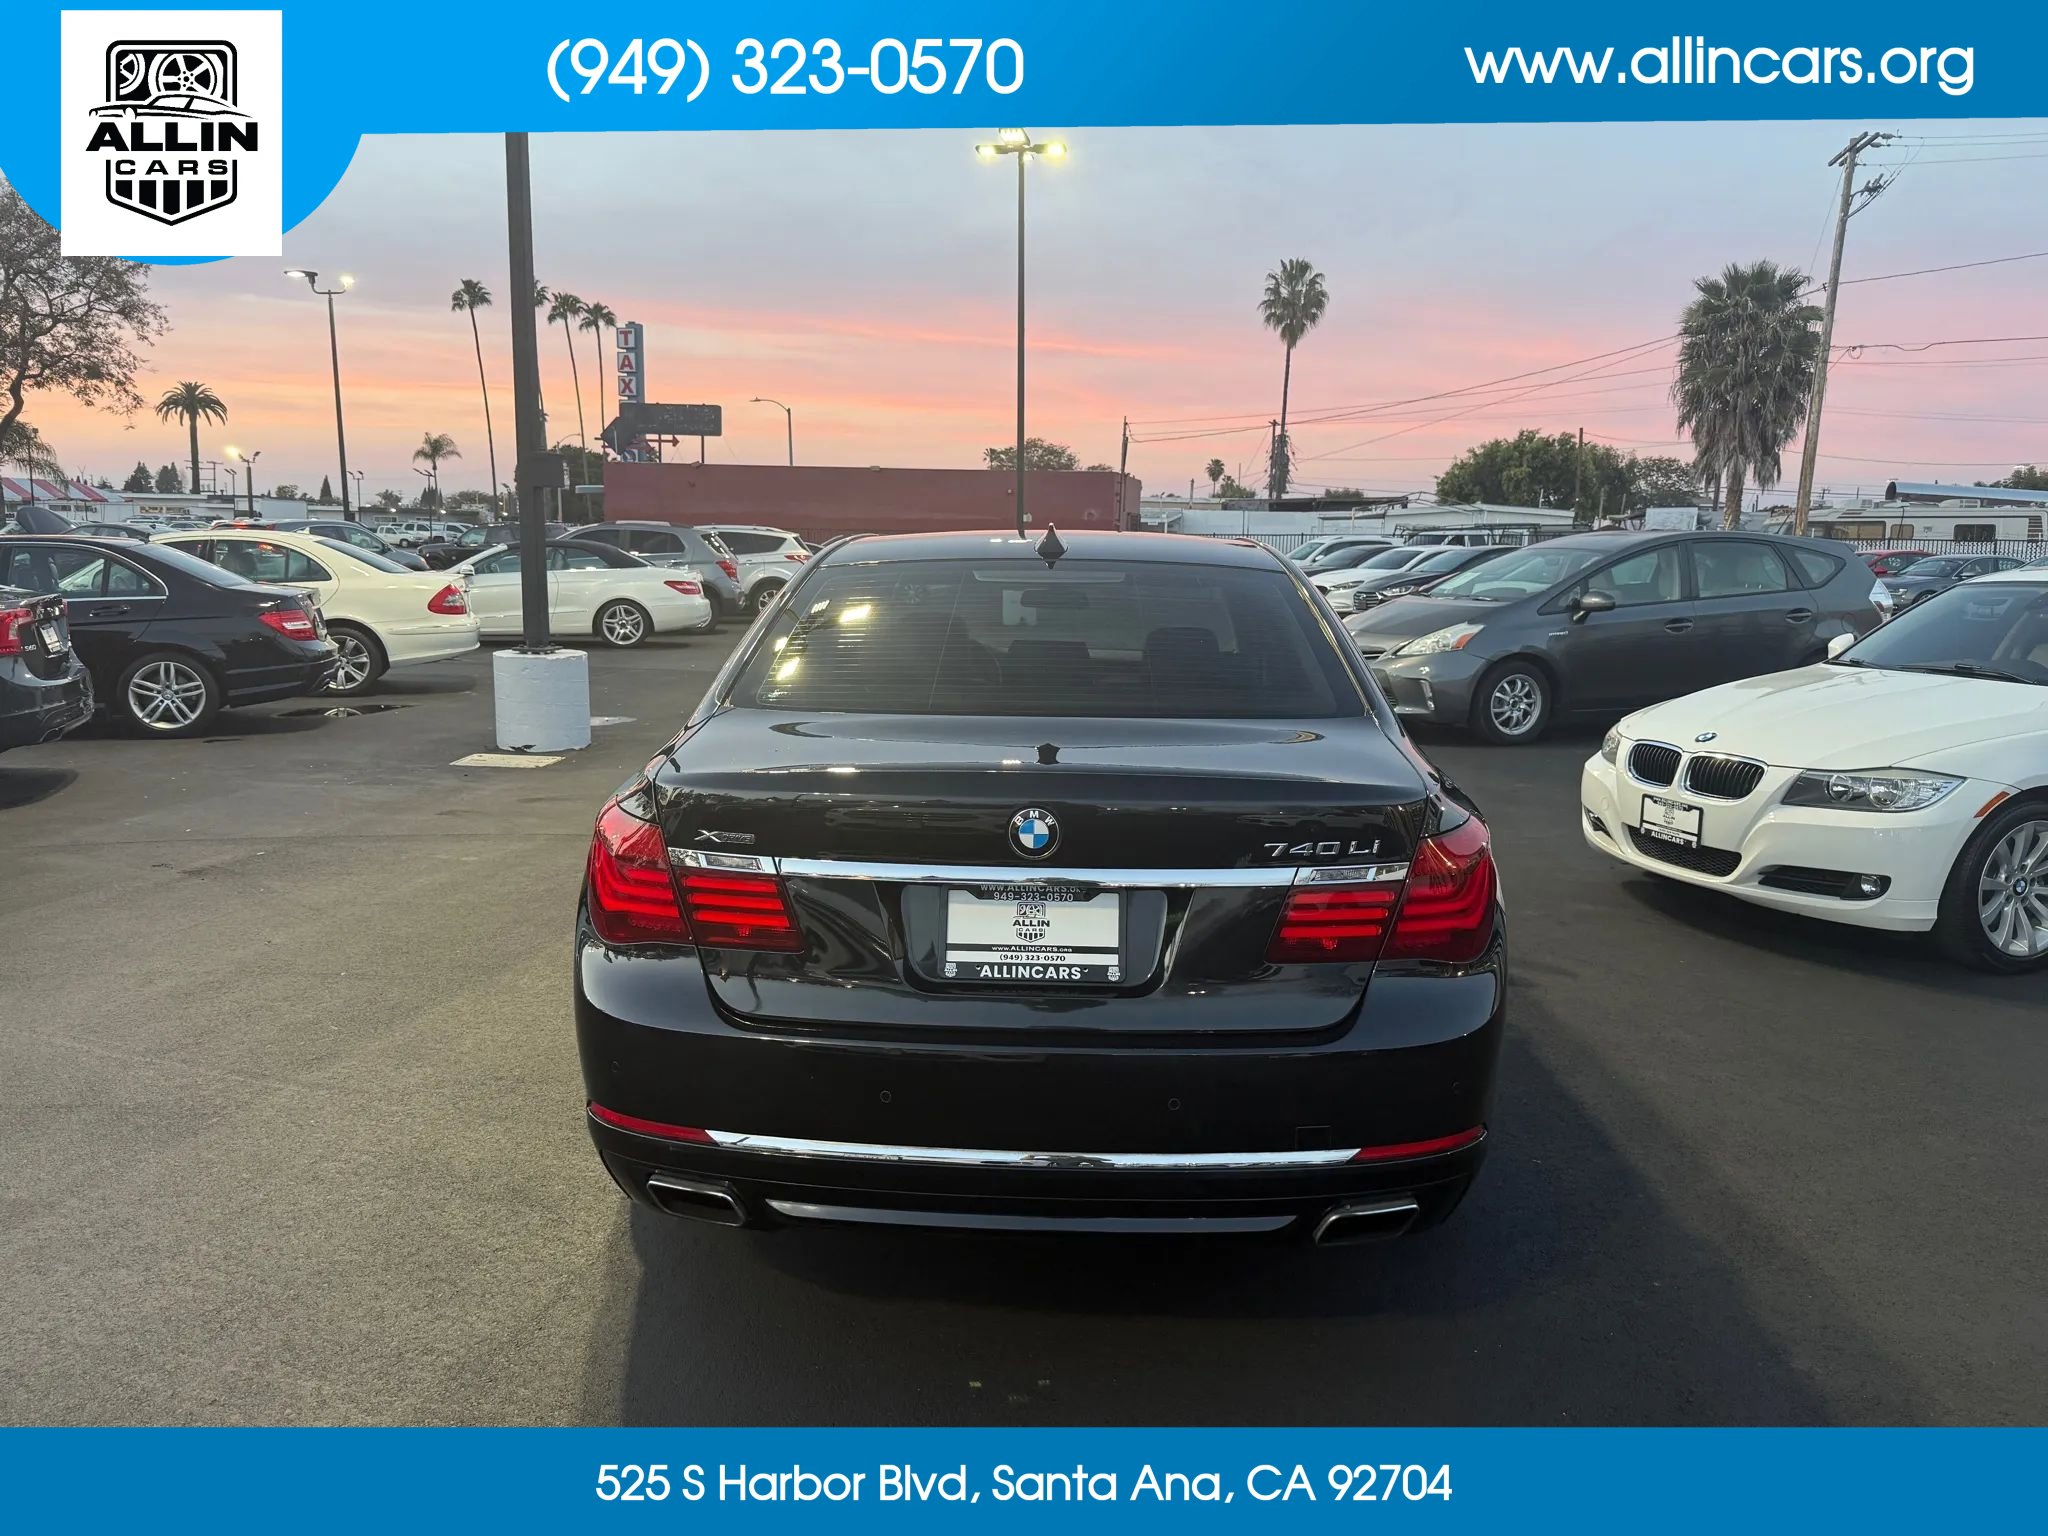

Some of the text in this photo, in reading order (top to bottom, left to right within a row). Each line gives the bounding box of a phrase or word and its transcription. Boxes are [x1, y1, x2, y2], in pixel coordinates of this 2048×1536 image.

[619, 330, 634, 393] TAX
[1015, 811, 1055, 827] BMW
[1651, 831, 1684, 845] ALLINCARS
[993, 892, 1074, 902] 949-323-0570
[1013, 919, 1050, 927] ALLIN
[1000, 953, 1023, 961] (949)
[979, 965, 1081, 979] ALLINCARS
